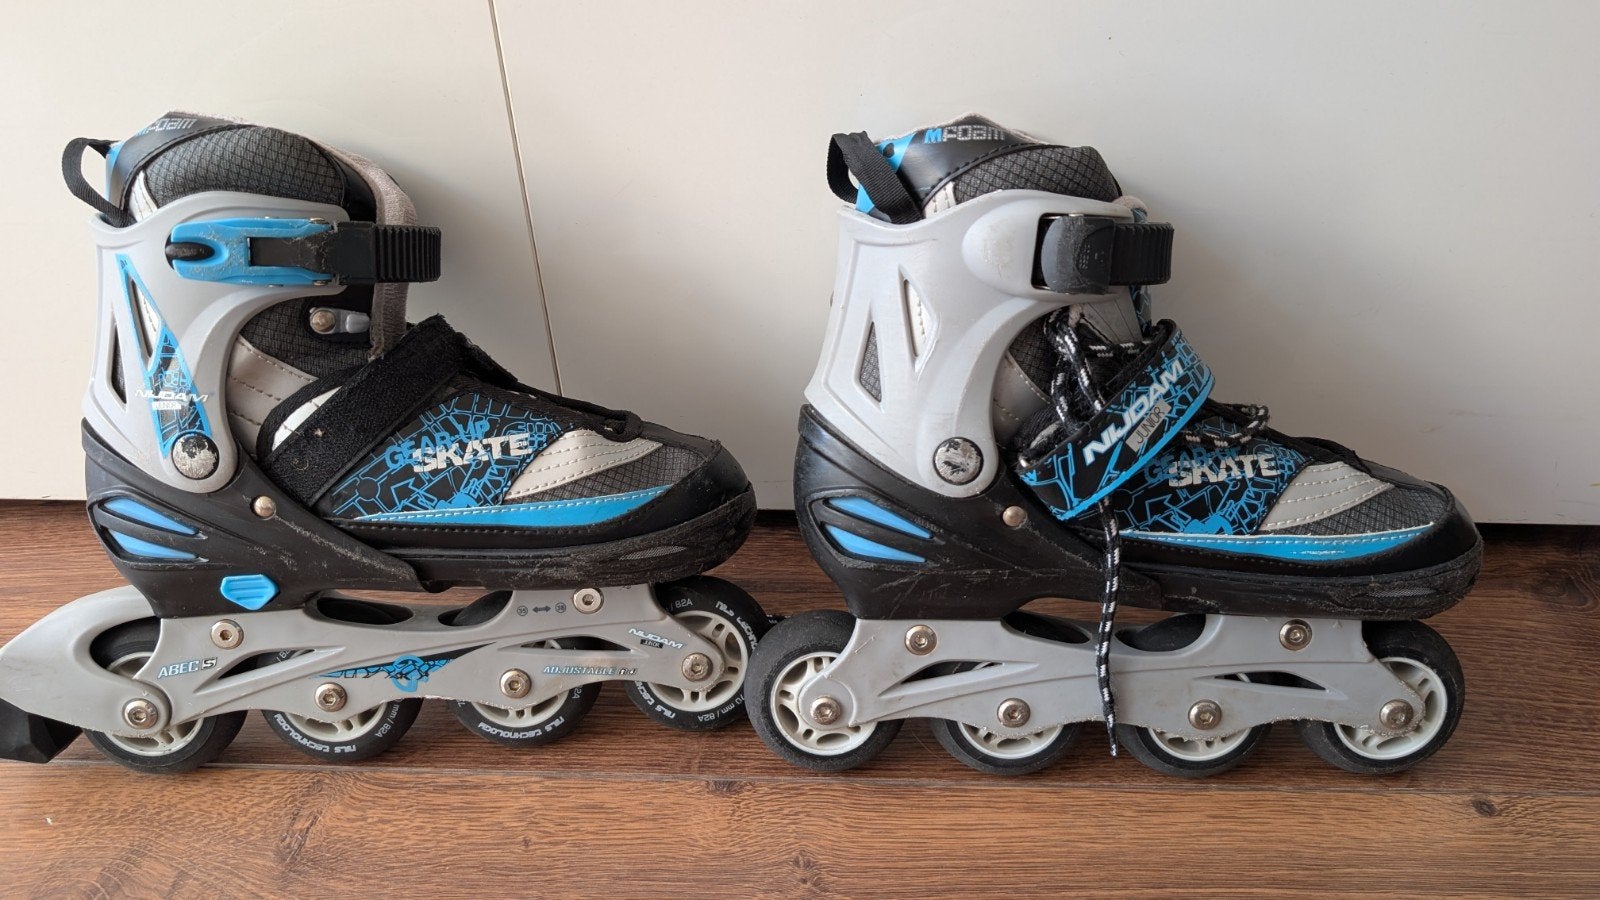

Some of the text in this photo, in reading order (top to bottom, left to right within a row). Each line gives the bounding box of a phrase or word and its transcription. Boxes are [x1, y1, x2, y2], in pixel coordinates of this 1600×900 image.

[1136, 406, 1166, 444] JUNIOR
[412, 432, 533, 473] SKATE
[1168, 454, 1280, 487] SKATE
[157, 660, 200, 679] ABEC
[697, 712, 715, 722] 82A
[374, 723, 391, 738] 82A
